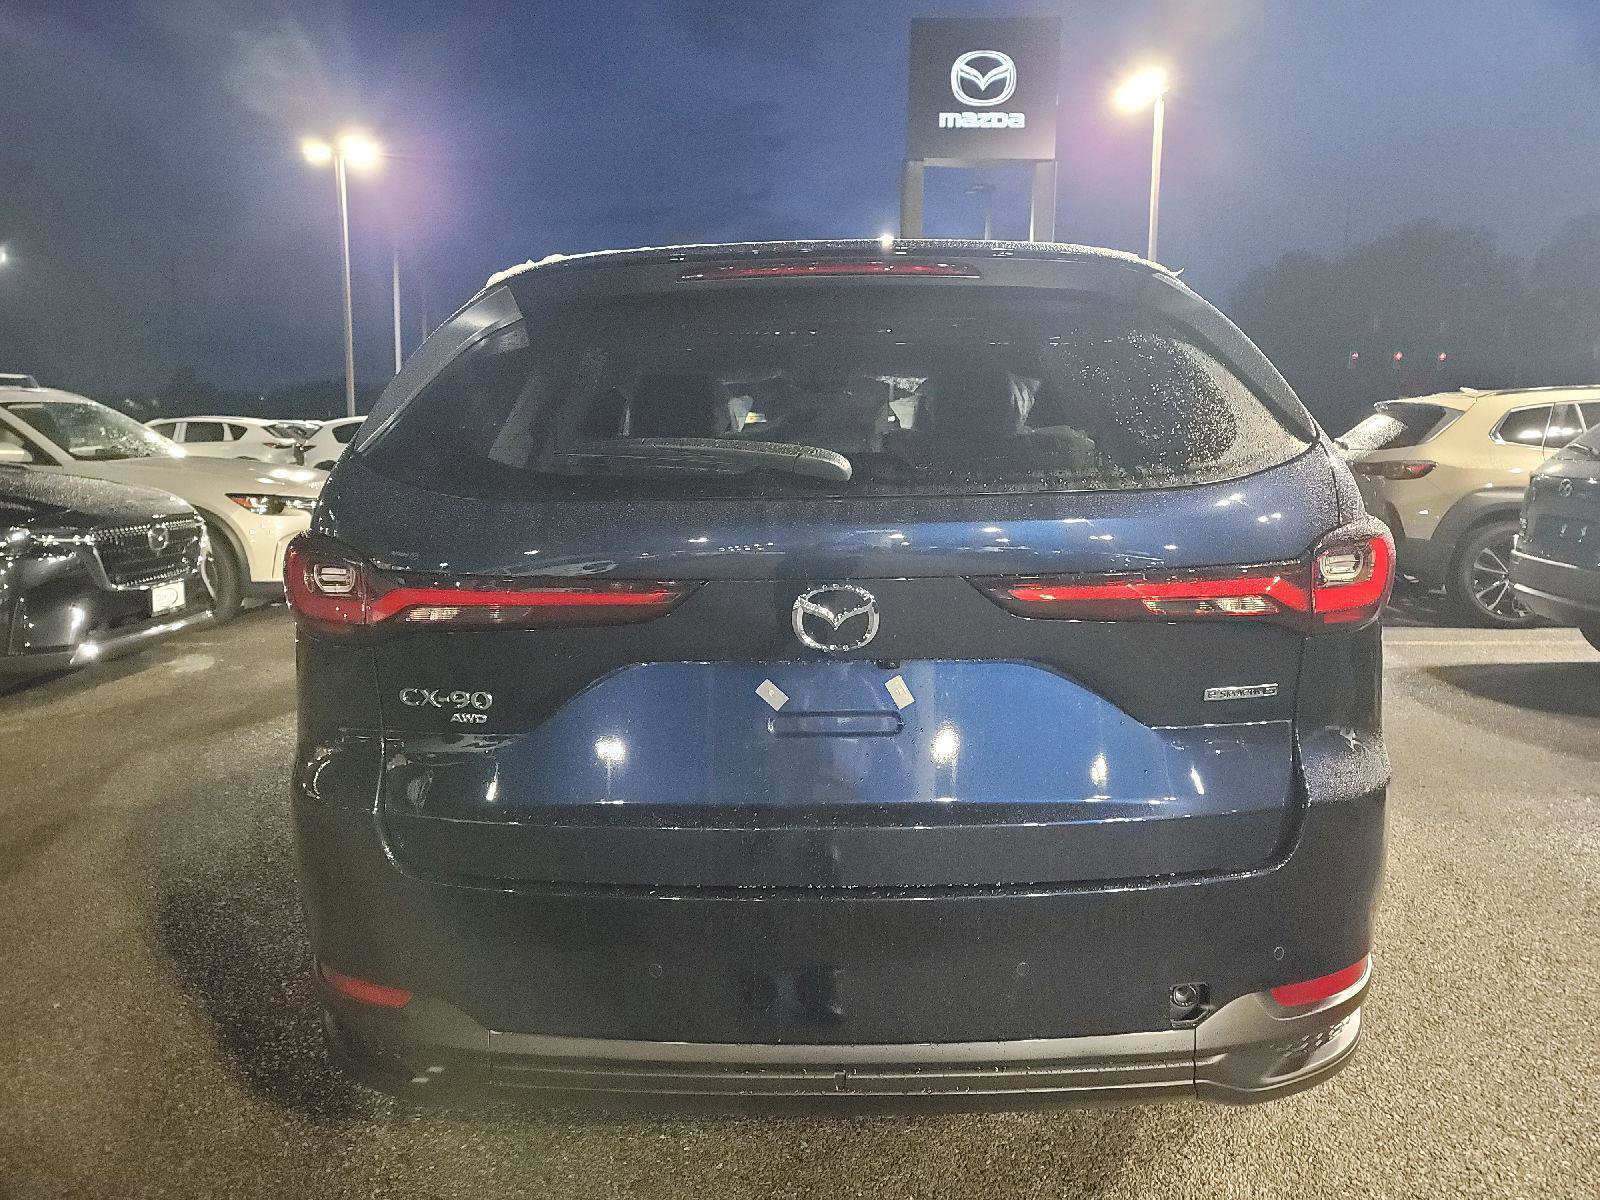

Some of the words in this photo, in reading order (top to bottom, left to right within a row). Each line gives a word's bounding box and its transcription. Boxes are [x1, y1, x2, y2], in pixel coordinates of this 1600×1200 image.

[939, 112, 1025, 128] mazda
[399, 688, 493, 710] CX-90
[450, 713, 488, 723] AWD
